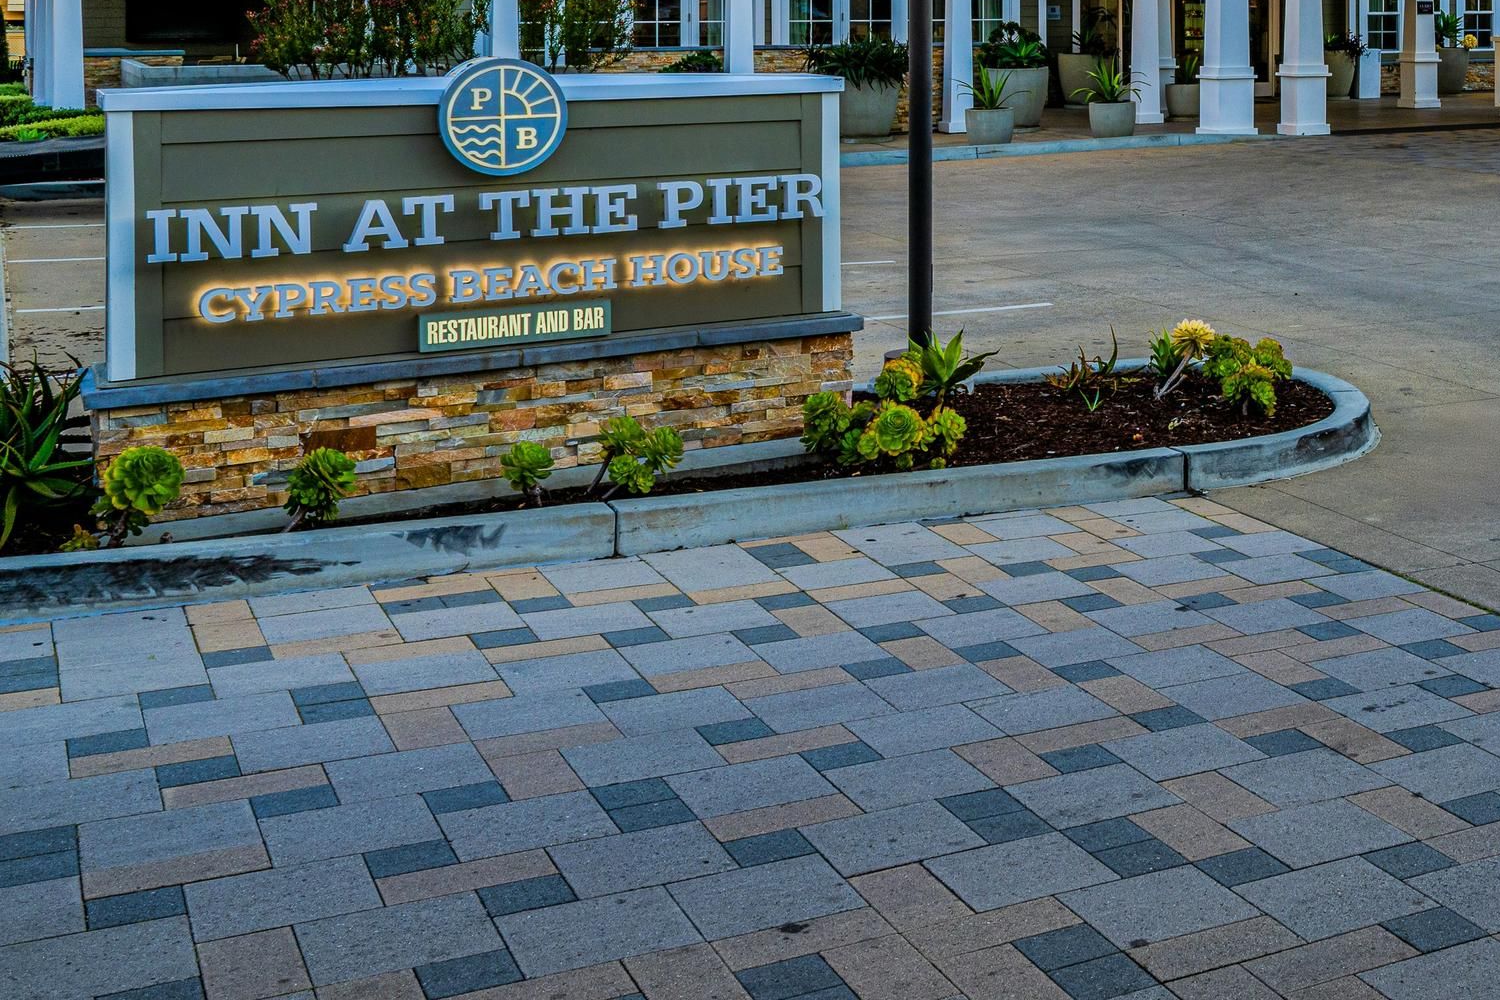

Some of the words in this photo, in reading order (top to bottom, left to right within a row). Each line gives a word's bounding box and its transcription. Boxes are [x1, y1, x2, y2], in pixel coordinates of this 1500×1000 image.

[470, 87, 492, 111] P
[515, 127, 538, 150] B
[145, 202, 318, 263] INN
[343, 194, 455, 253] AT
[478, 183, 638, 241] THE
[656, 173, 825, 230] PIER
[199, 272, 437, 323] CYPRESS
[449, 257, 618, 304] BEACH
[628, 245, 785, 288] HOUSE
[427, 312, 532, 345] RESTAURANT
[535, 309, 569, 335] AND
[573, 306, 605, 331] BAR
